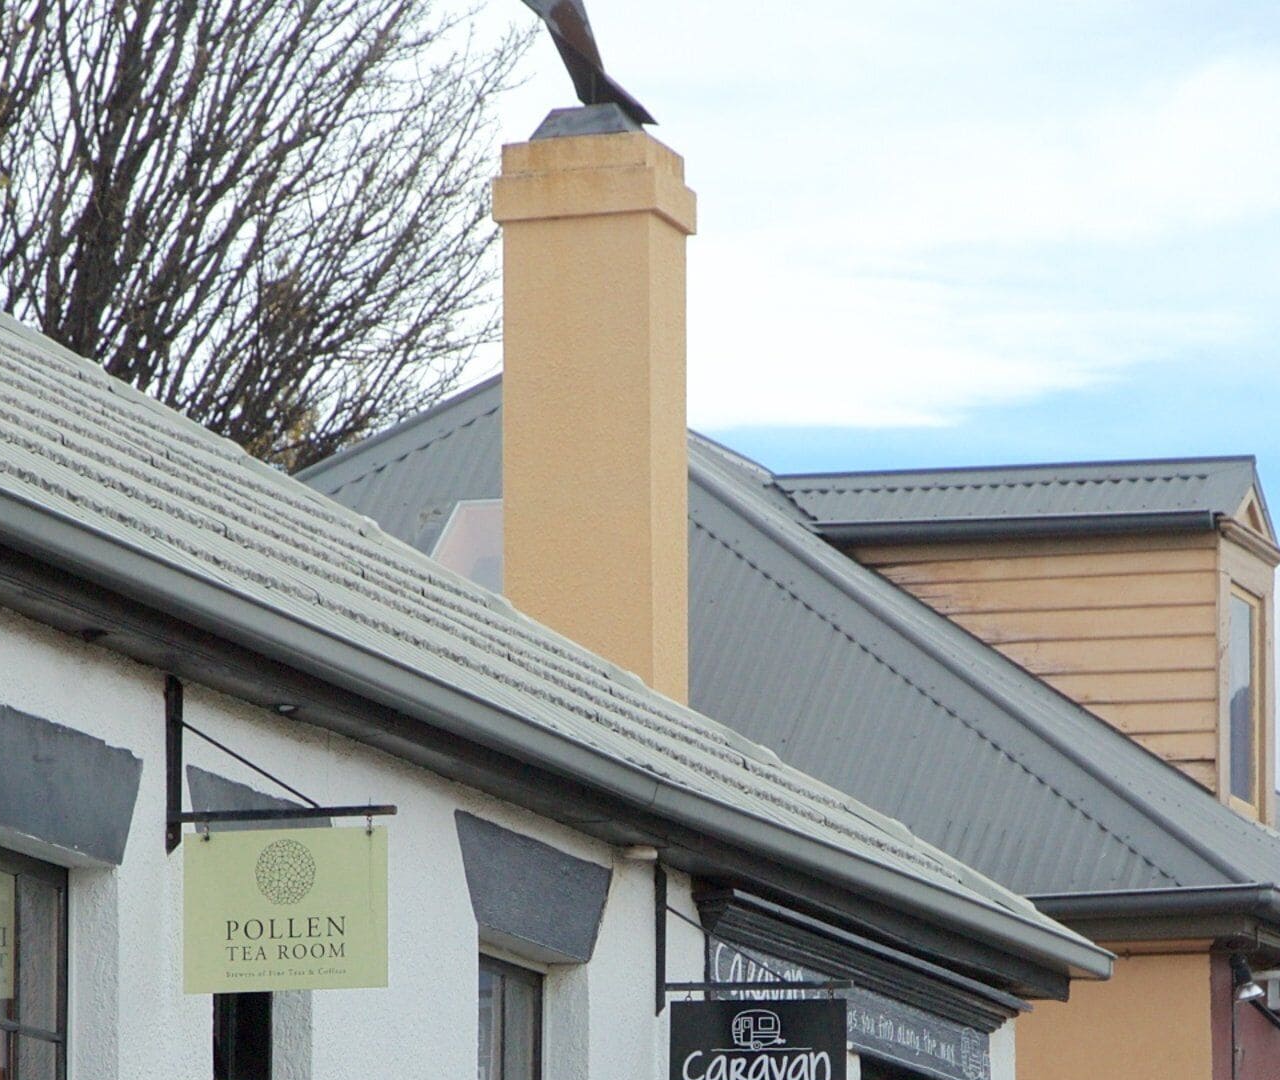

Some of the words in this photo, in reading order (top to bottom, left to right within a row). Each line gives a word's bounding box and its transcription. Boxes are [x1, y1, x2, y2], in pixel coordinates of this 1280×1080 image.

[225, 915, 346, 941] POLLEN
[225, 945, 267, 961] TEA
[278, 942, 346, 960] ROOM
